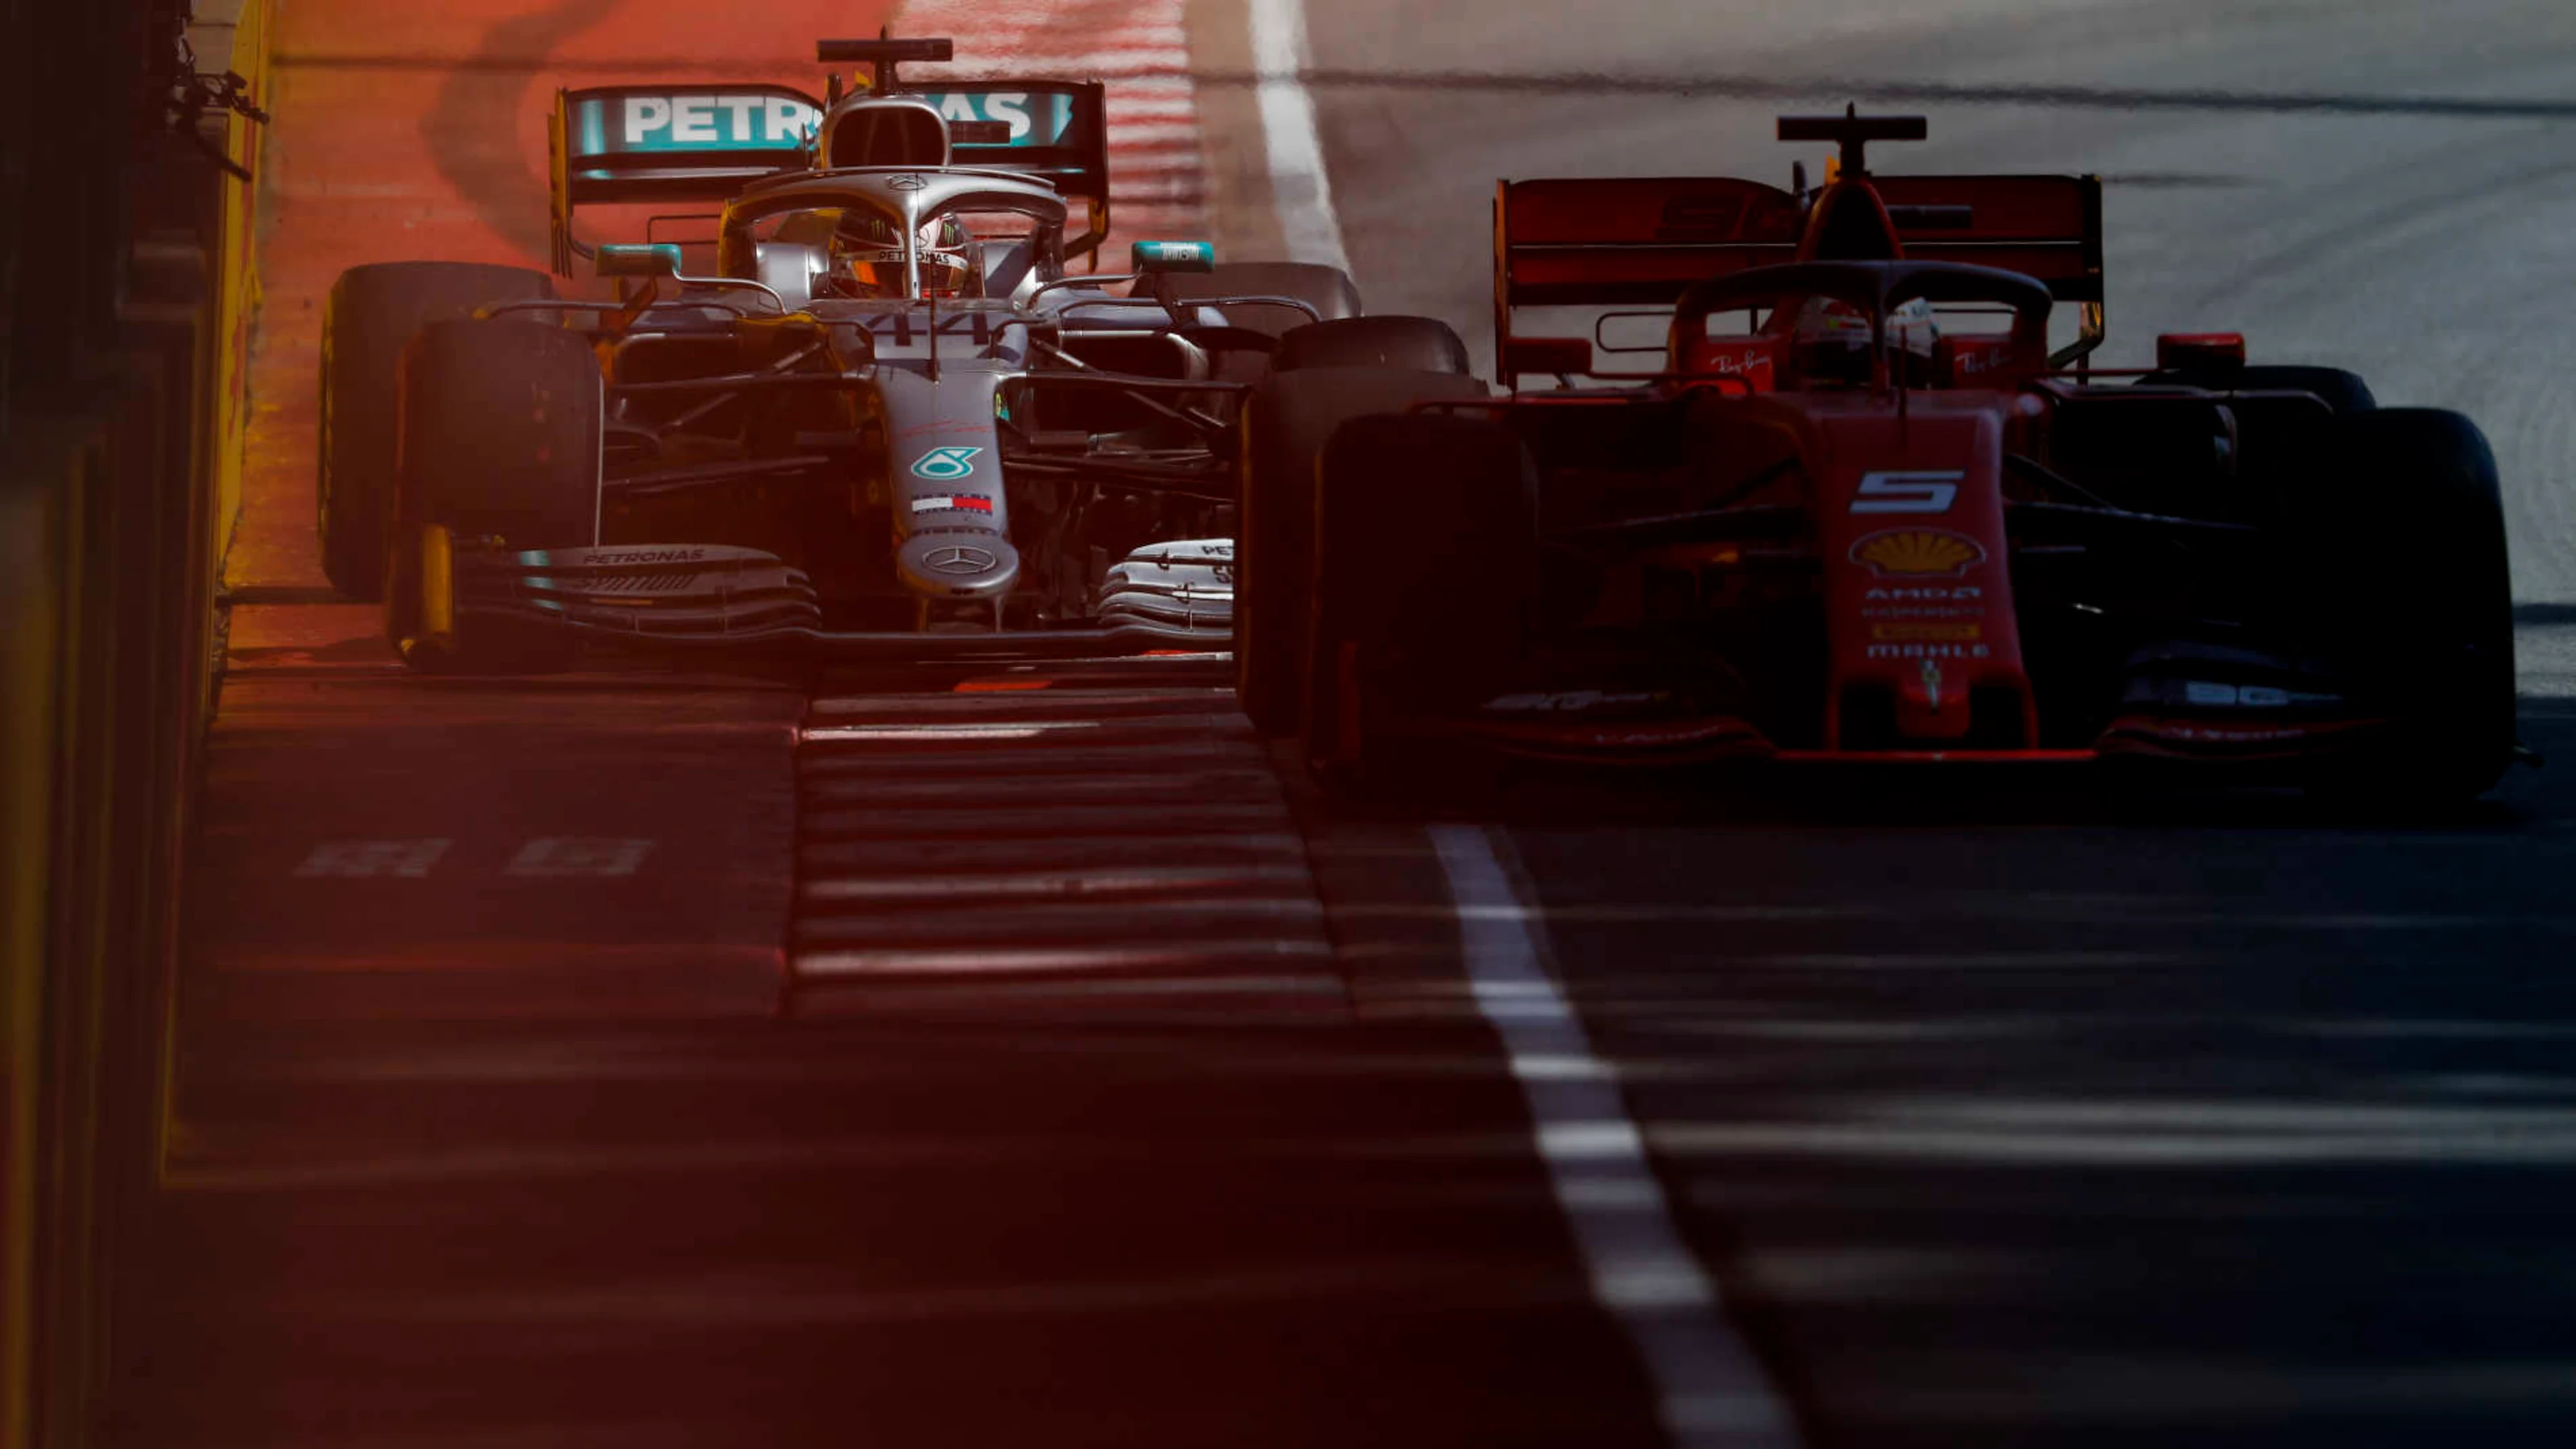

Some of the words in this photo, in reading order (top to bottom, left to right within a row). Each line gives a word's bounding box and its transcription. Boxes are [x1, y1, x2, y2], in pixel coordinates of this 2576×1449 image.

[625, 93, 1031, 143] PETRAS
[879, 250, 951, 264] PETONAS
[865, 312, 994, 346] 44
[1848, 469, 1966, 515] 5
[584, 549, 705, 564] PETRONAS
[1865, 587, 1949, 600] AMD
[1867, 644, 1990, 658] MAHLE
